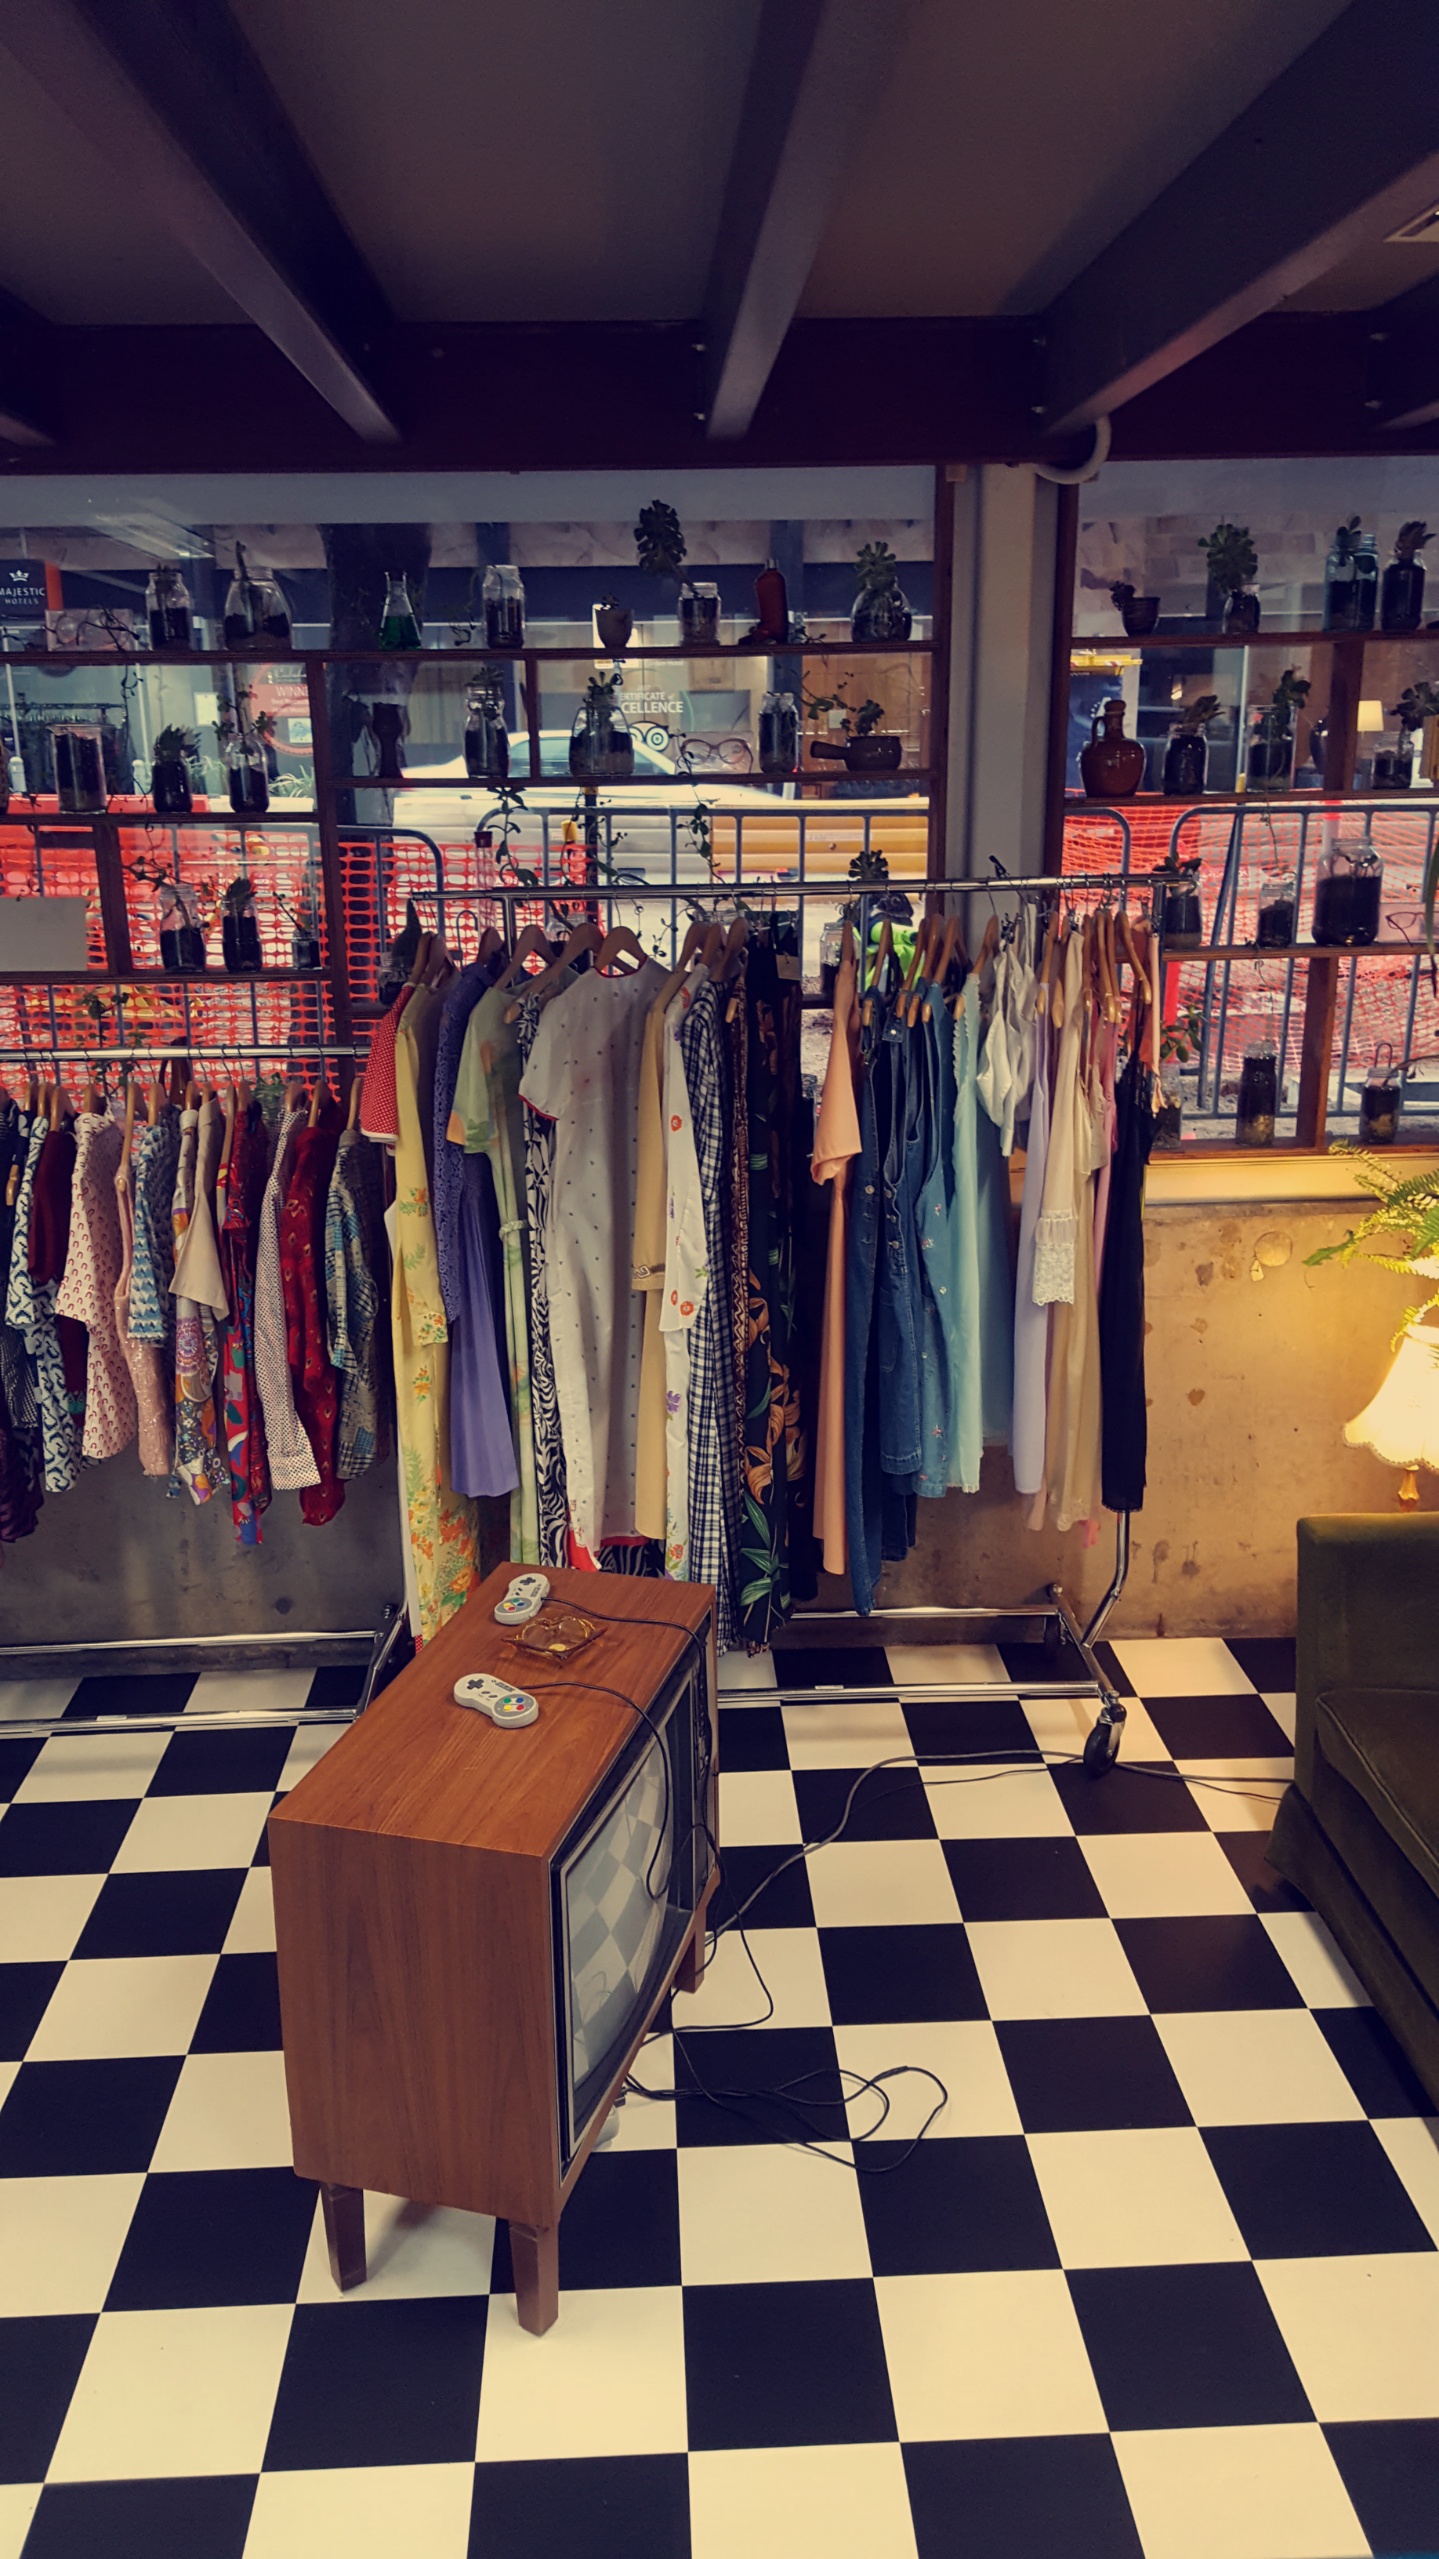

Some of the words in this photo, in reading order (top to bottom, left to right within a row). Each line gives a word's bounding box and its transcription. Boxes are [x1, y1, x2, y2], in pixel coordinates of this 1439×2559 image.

[0, 587, 45, 597] MAJESTIC
[620, 692, 666, 701] ERTIFICATE
[621, 701, 684, 714] CELLENCE
